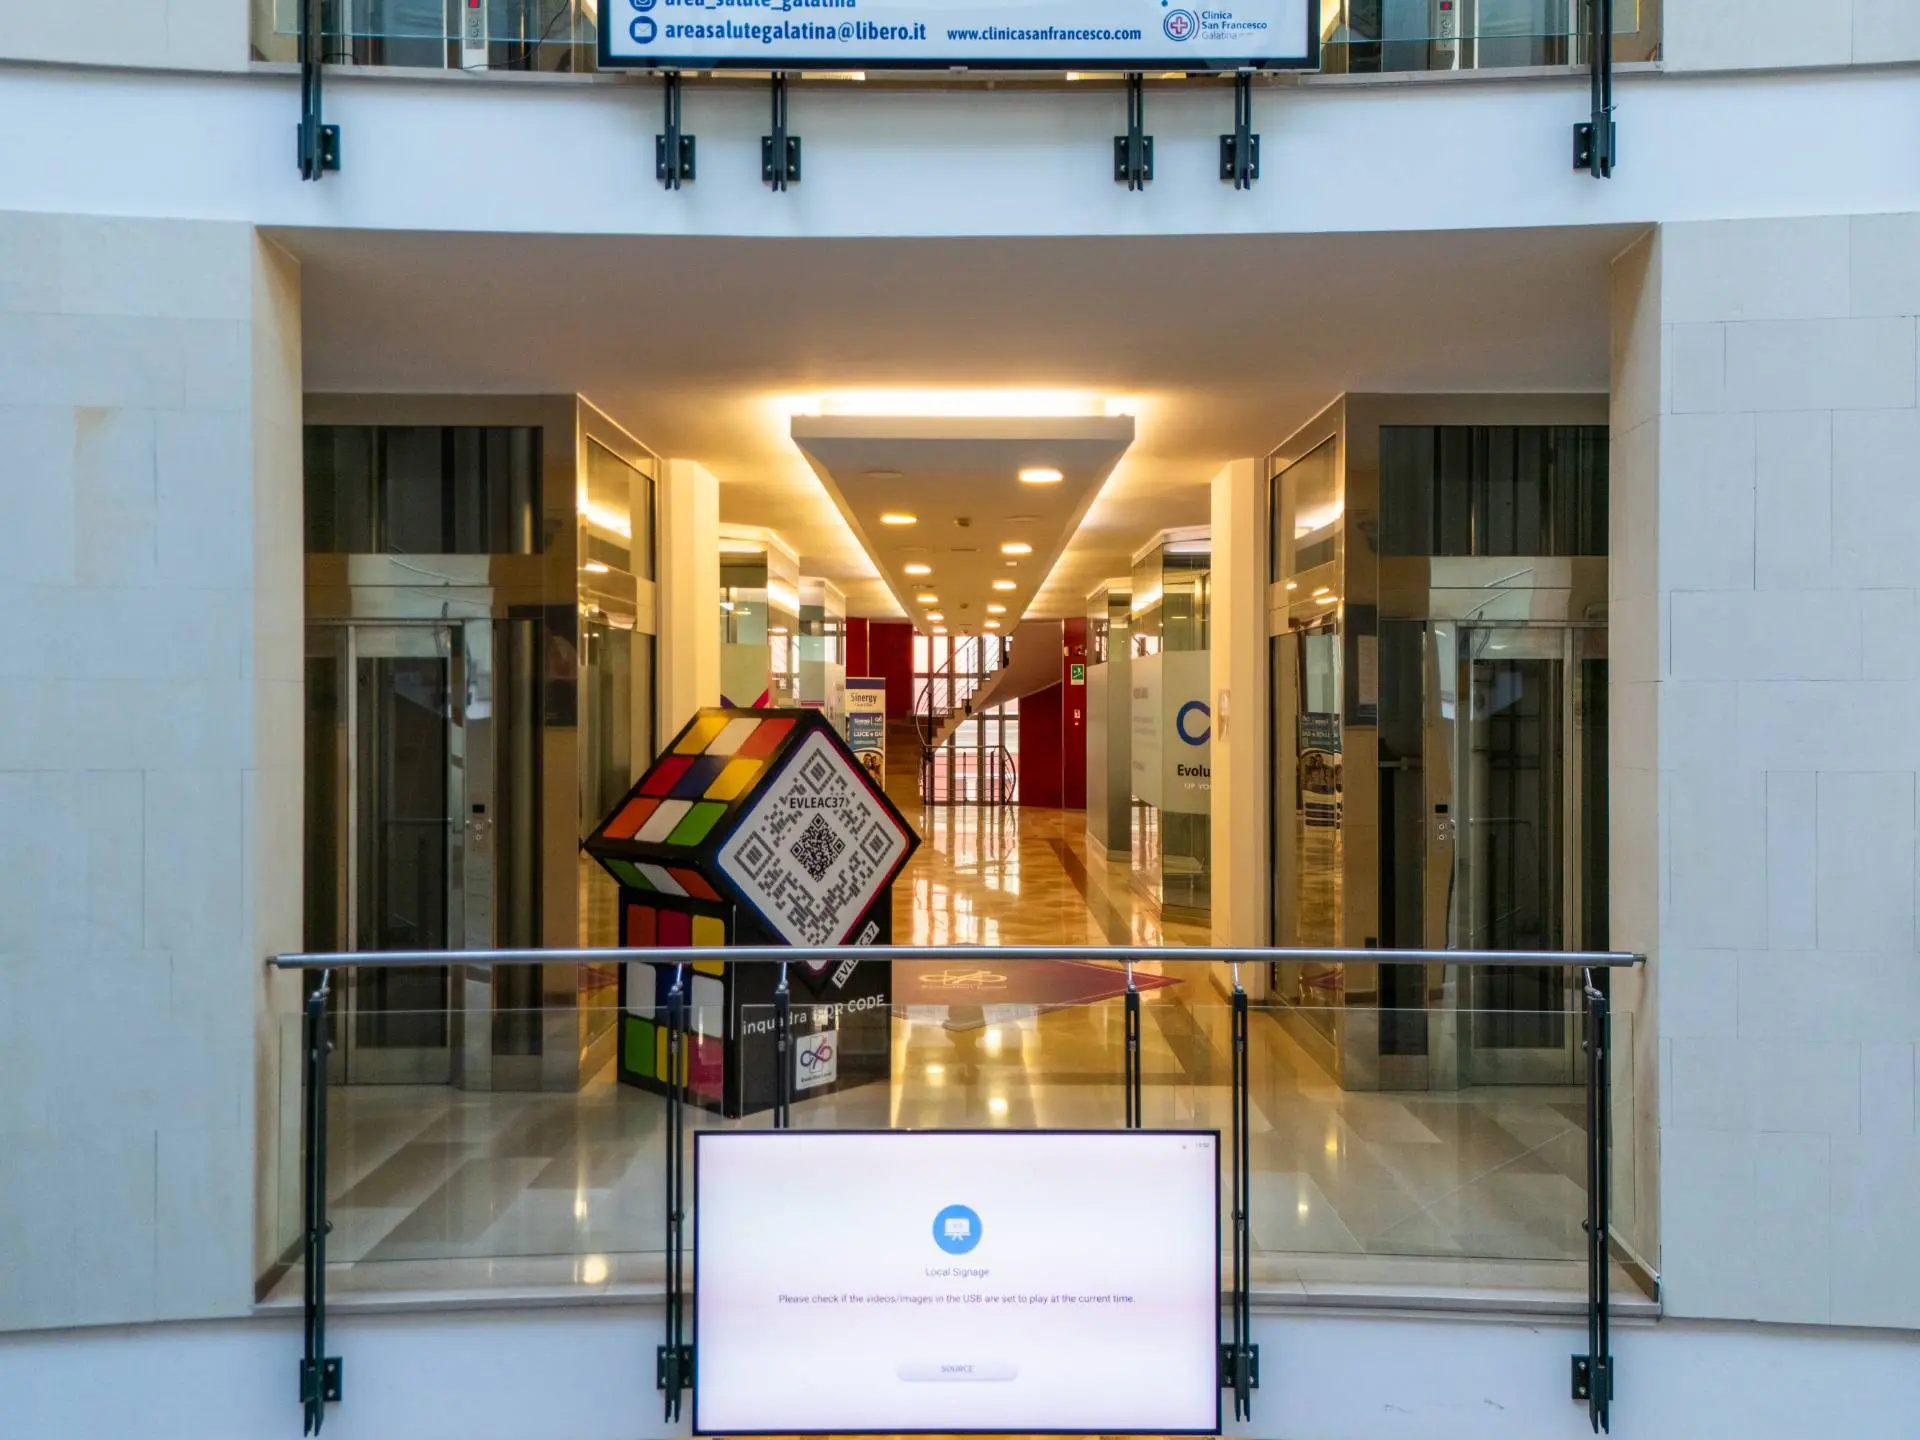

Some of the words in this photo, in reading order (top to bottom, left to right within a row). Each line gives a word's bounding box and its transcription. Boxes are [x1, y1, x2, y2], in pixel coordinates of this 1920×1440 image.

[1201, 10, 1232, 20] Clinica
[665, 20, 926, 43] areasalutegalatina@libero.it
[1201, 21, 1219, 30] San
[1221, 21, 1268, 30] Francesco
[947, 26, 1141, 40] www.clinicasanfrancesco.com
[1201, 31, 1238, 40] Galatina
[850, 692, 878, 704] Sinergy
[1177, 764, 1210, 777] Evolu
[789, 797, 845, 809] EVLEAC37
[835, 923, 877, 985] EVLC37
[847, 994, 885, 1013] CODE
[925, 1267, 951, 1277] Local
[952, 1267, 990, 1279] Signage
[778, 1294, 810, 1304] Please
[811, 1294, 838, 1304] check
[841, 1294, 847, 1304] if
[849, 1294, 864, 1304] the
[935, 1294, 944, 1304] in
[946, 1294, 961, 1304] the
[962, 1294, 983, 1304] USB
[1001, 1294, 1016, 1304] set
[1017, 1294, 1028, 1304] to
[1029, 1294, 1049, 1305] play
[1050, 1294, 1060, 1304] at
[1061, 1294, 1077, 1304] the
[1078, 1294, 1111, 1304] current
[1112, 1294, 1136, 1304] time.
